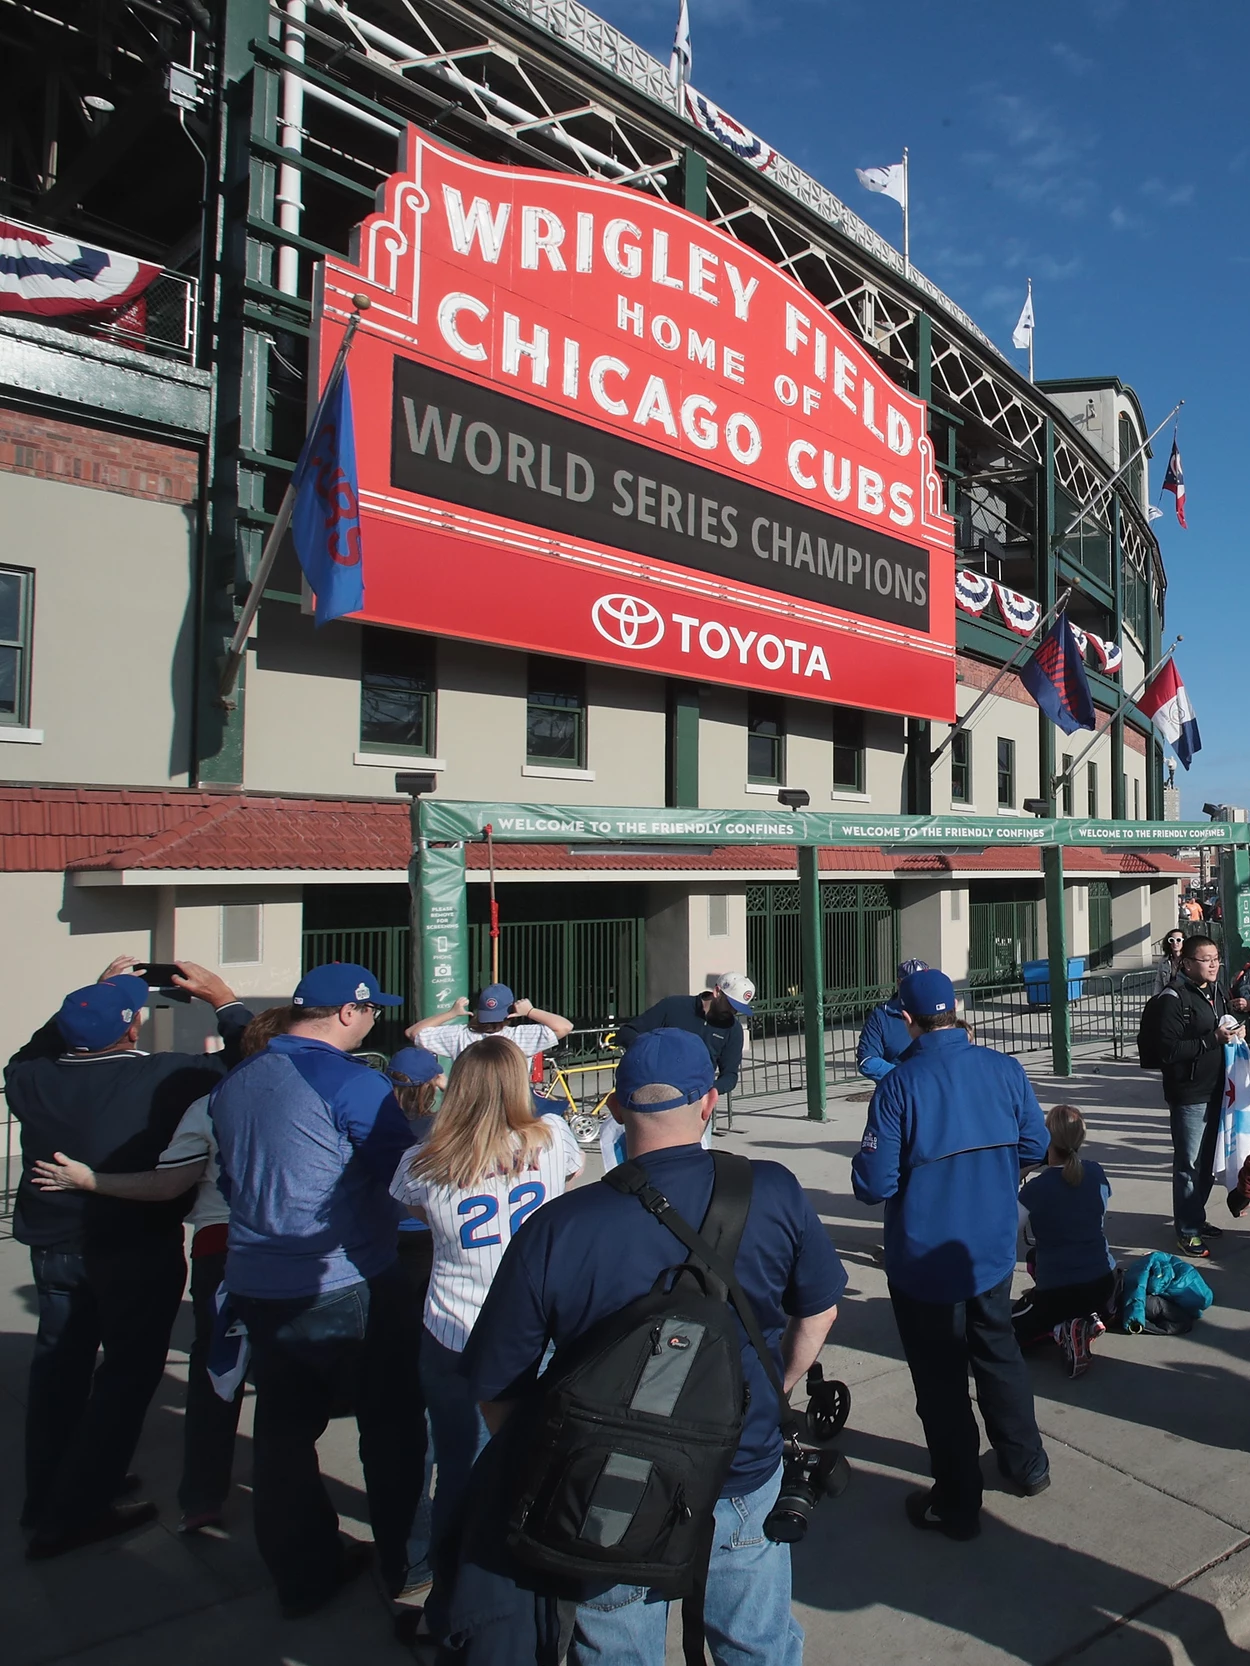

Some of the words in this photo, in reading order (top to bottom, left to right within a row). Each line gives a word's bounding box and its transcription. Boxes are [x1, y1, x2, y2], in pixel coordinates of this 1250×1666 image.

[442, 183, 759, 322] WRIGLEY
[785, 301, 914, 456] FIELD
[617, 294, 745, 385] HOME
[774, 374, 822, 416] OF
[437, 291, 762, 466] CHICAGO
[788, 439, 915, 527] CUBS
[402, 396, 596, 503] WORLD
[612, 469, 738, 549] SERIES
[751, 517, 927, 607] CHAMPIONS
[671, 612, 832, 681] TOYOTA
[497, 818, 585, 833] WELCOME
[589, 820, 612, 834] TO
[616, 821, 647, 834] THE
[651, 822, 722, 835] FRIENDLY
[725, 822, 795, 836] CONFINES
[841, 825, 900, 837] WELCOME
[903, 826, 918, 837] TO
[921, 826, 943, 837] THE
[945, 826, 994, 838] FRIENDLY
[996, 827, 1046, 838] CONFINES
[1078, 828, 1121, 839] WELCOME
[1122, 828, 1134, 838] TO
[1134, 828, 1151, 838] THE
[1152, 828, 1188, 838] FRIENDLY
[1189, 828, 1226, 838] CONFINES
[457, 1180, 546, 1250] 22
